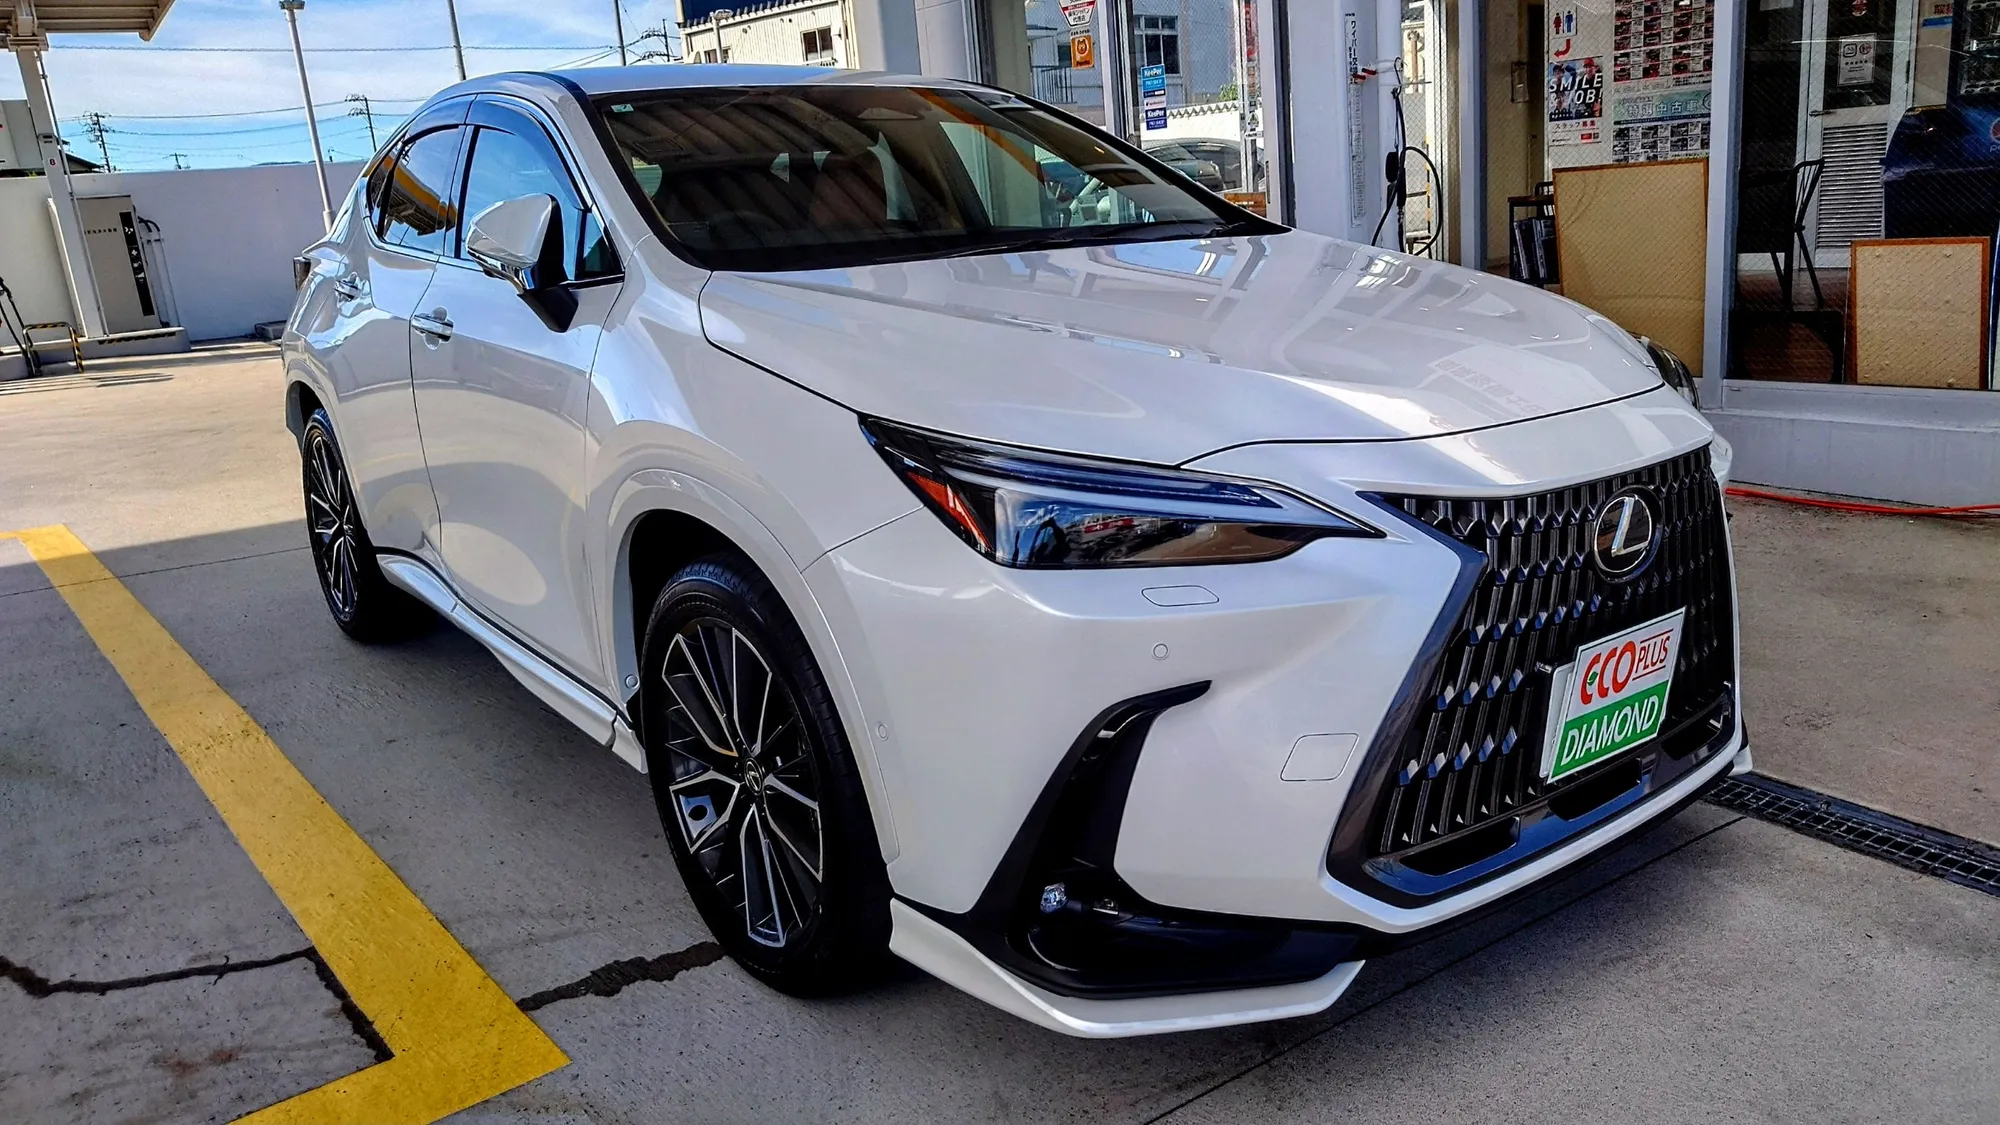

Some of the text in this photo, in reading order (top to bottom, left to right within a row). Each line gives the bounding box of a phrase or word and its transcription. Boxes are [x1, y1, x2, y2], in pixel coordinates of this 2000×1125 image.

[1549, 73, 1602, 93] SMILE
[1635, 635, 1670, 673] PLUS
[1561, 695, 1659, 767] DIAMOND
